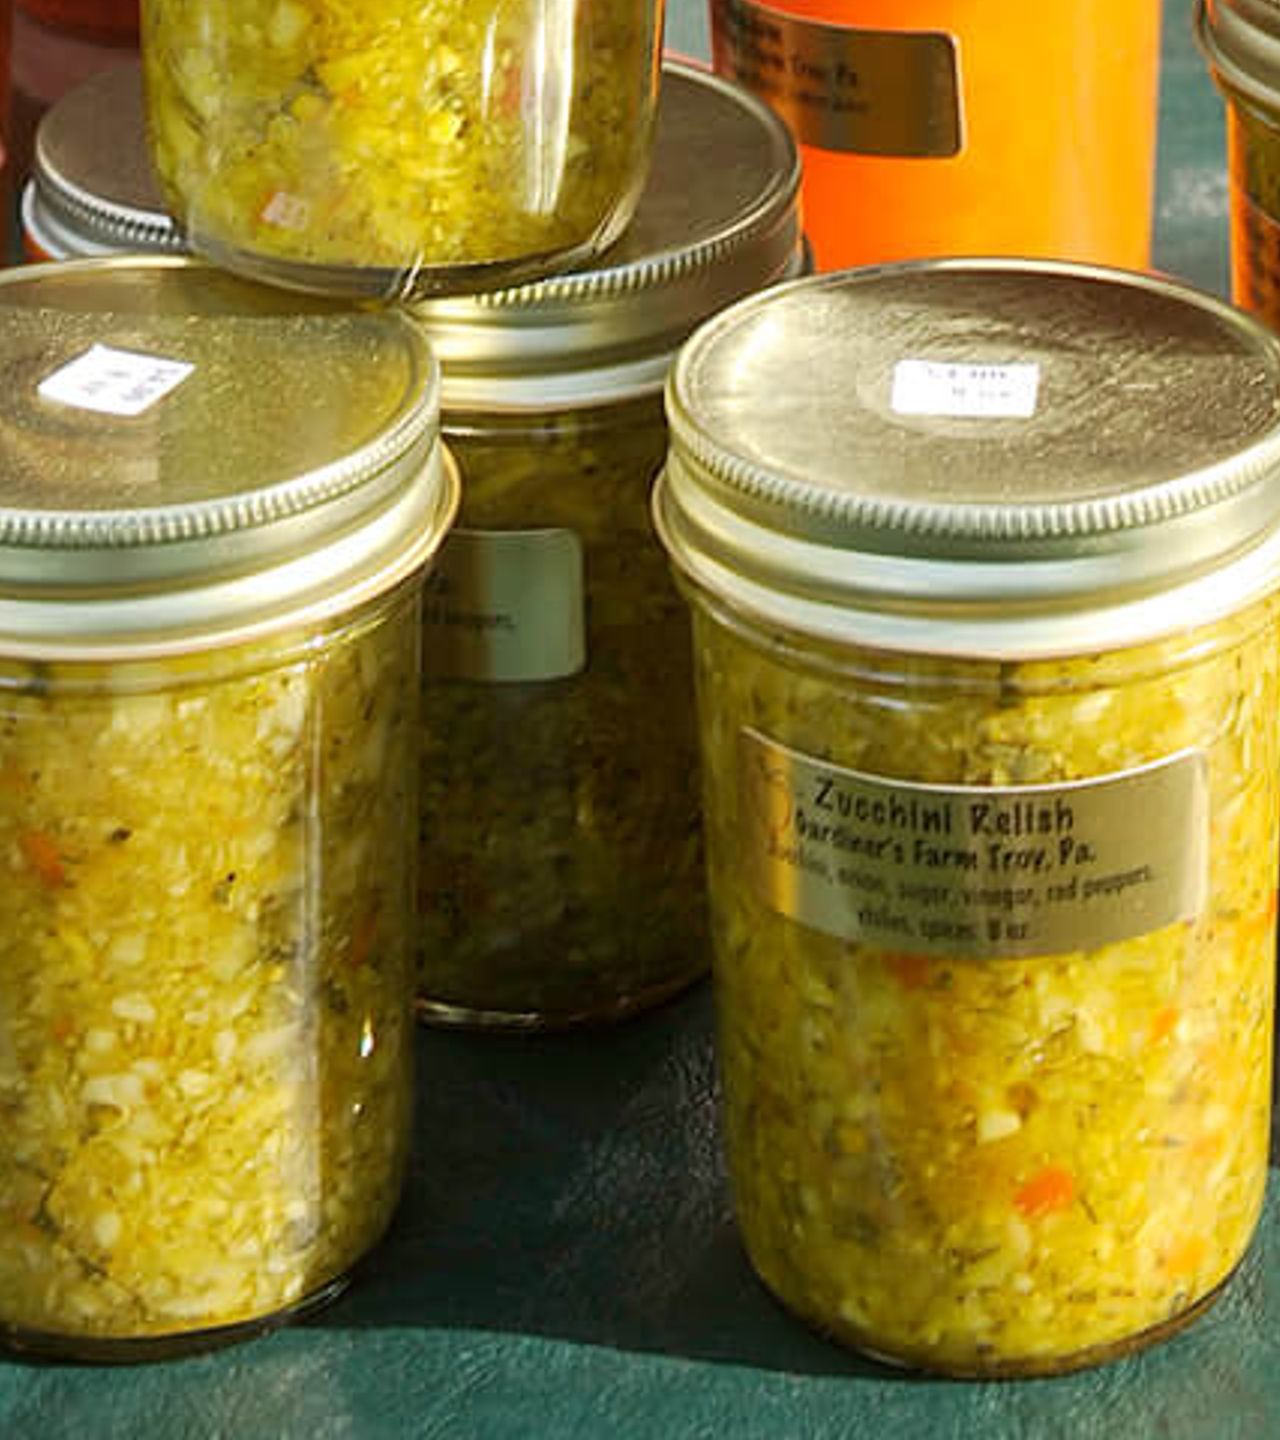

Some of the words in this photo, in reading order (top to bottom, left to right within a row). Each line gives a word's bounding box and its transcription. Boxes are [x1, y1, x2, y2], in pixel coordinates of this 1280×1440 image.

[815, 776, 951, 834] Zucchini
[970, 797, 1074, 836] Relish
[913, 840, 978, 871] Farm
[987, 842, 1052, 874] Troy,
[1059, 834, 1097, 866] Pa.
